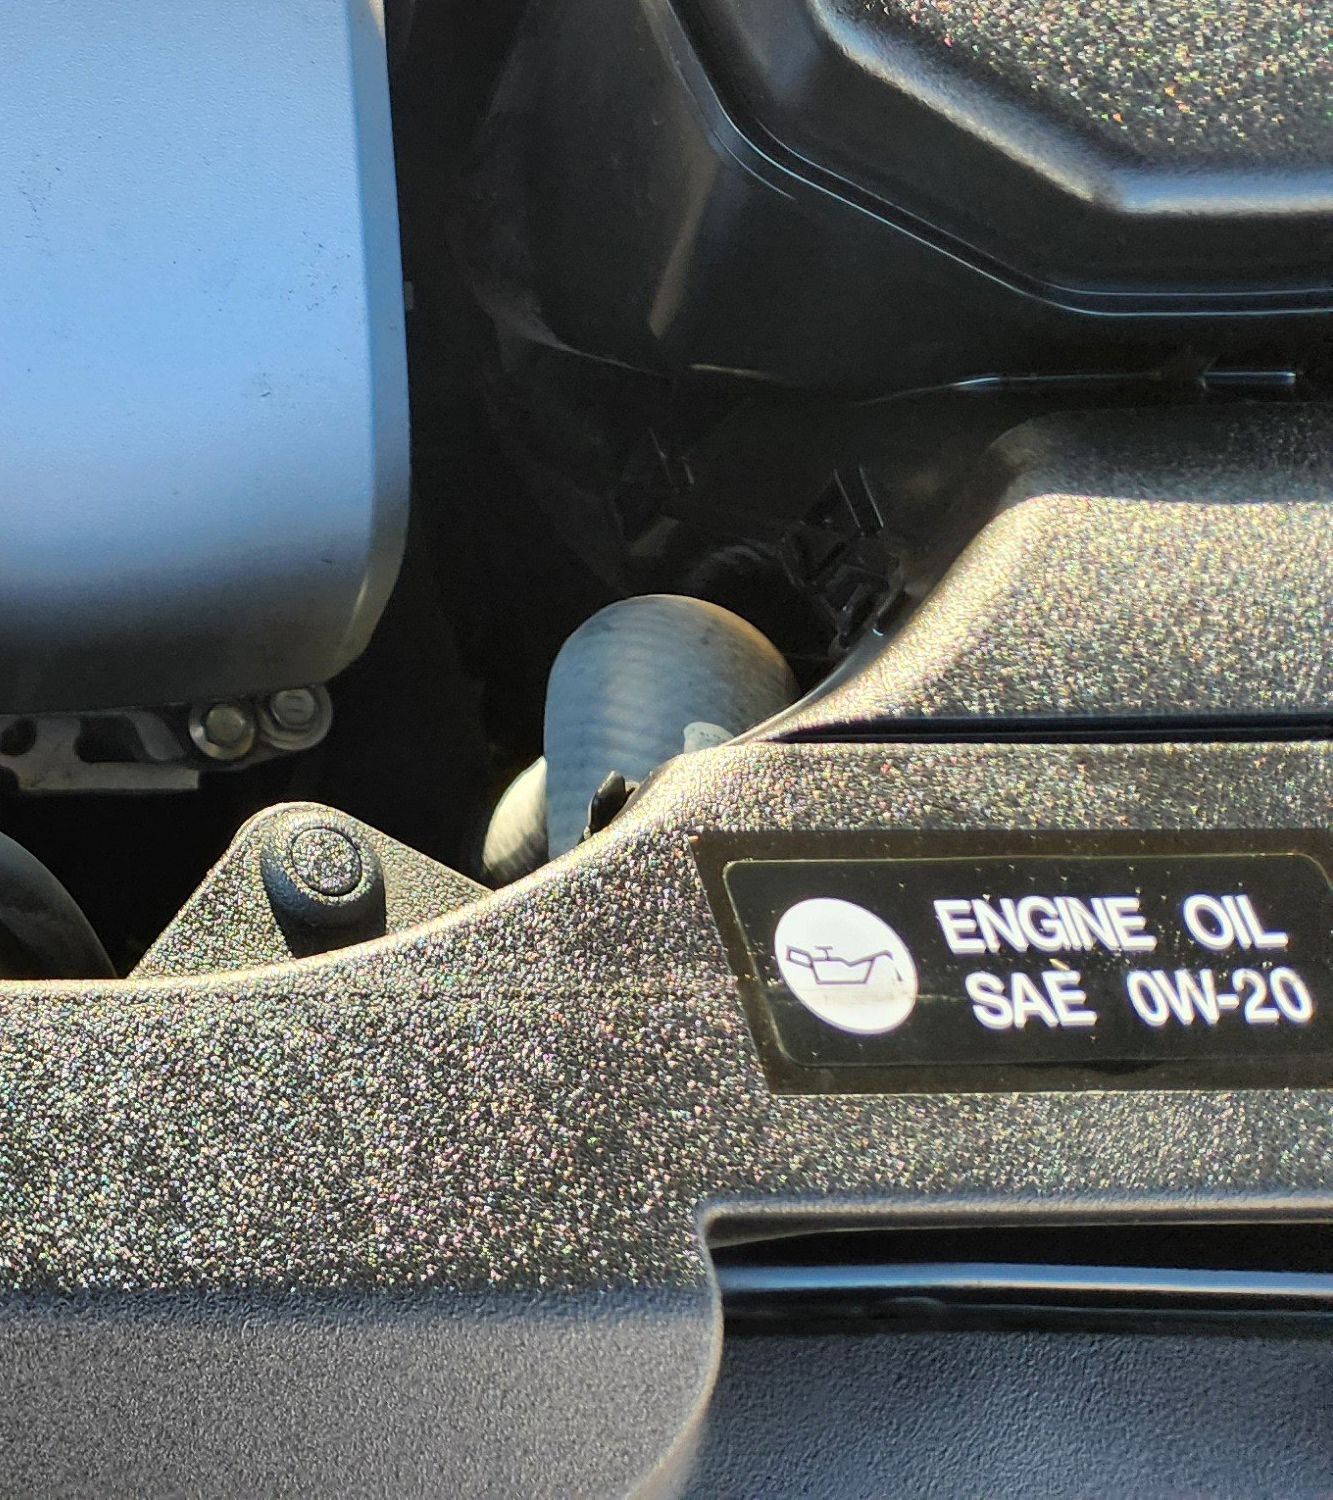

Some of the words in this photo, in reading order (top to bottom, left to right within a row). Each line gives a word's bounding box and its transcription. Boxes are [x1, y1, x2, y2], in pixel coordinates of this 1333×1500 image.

[933, 897, 1158, 954] ENGINE
[1183, 894, 1289, 950] OIL
[964, 970, 1098, 1030] SAE
[1126, 966, 1314, 1027] 0W-20
